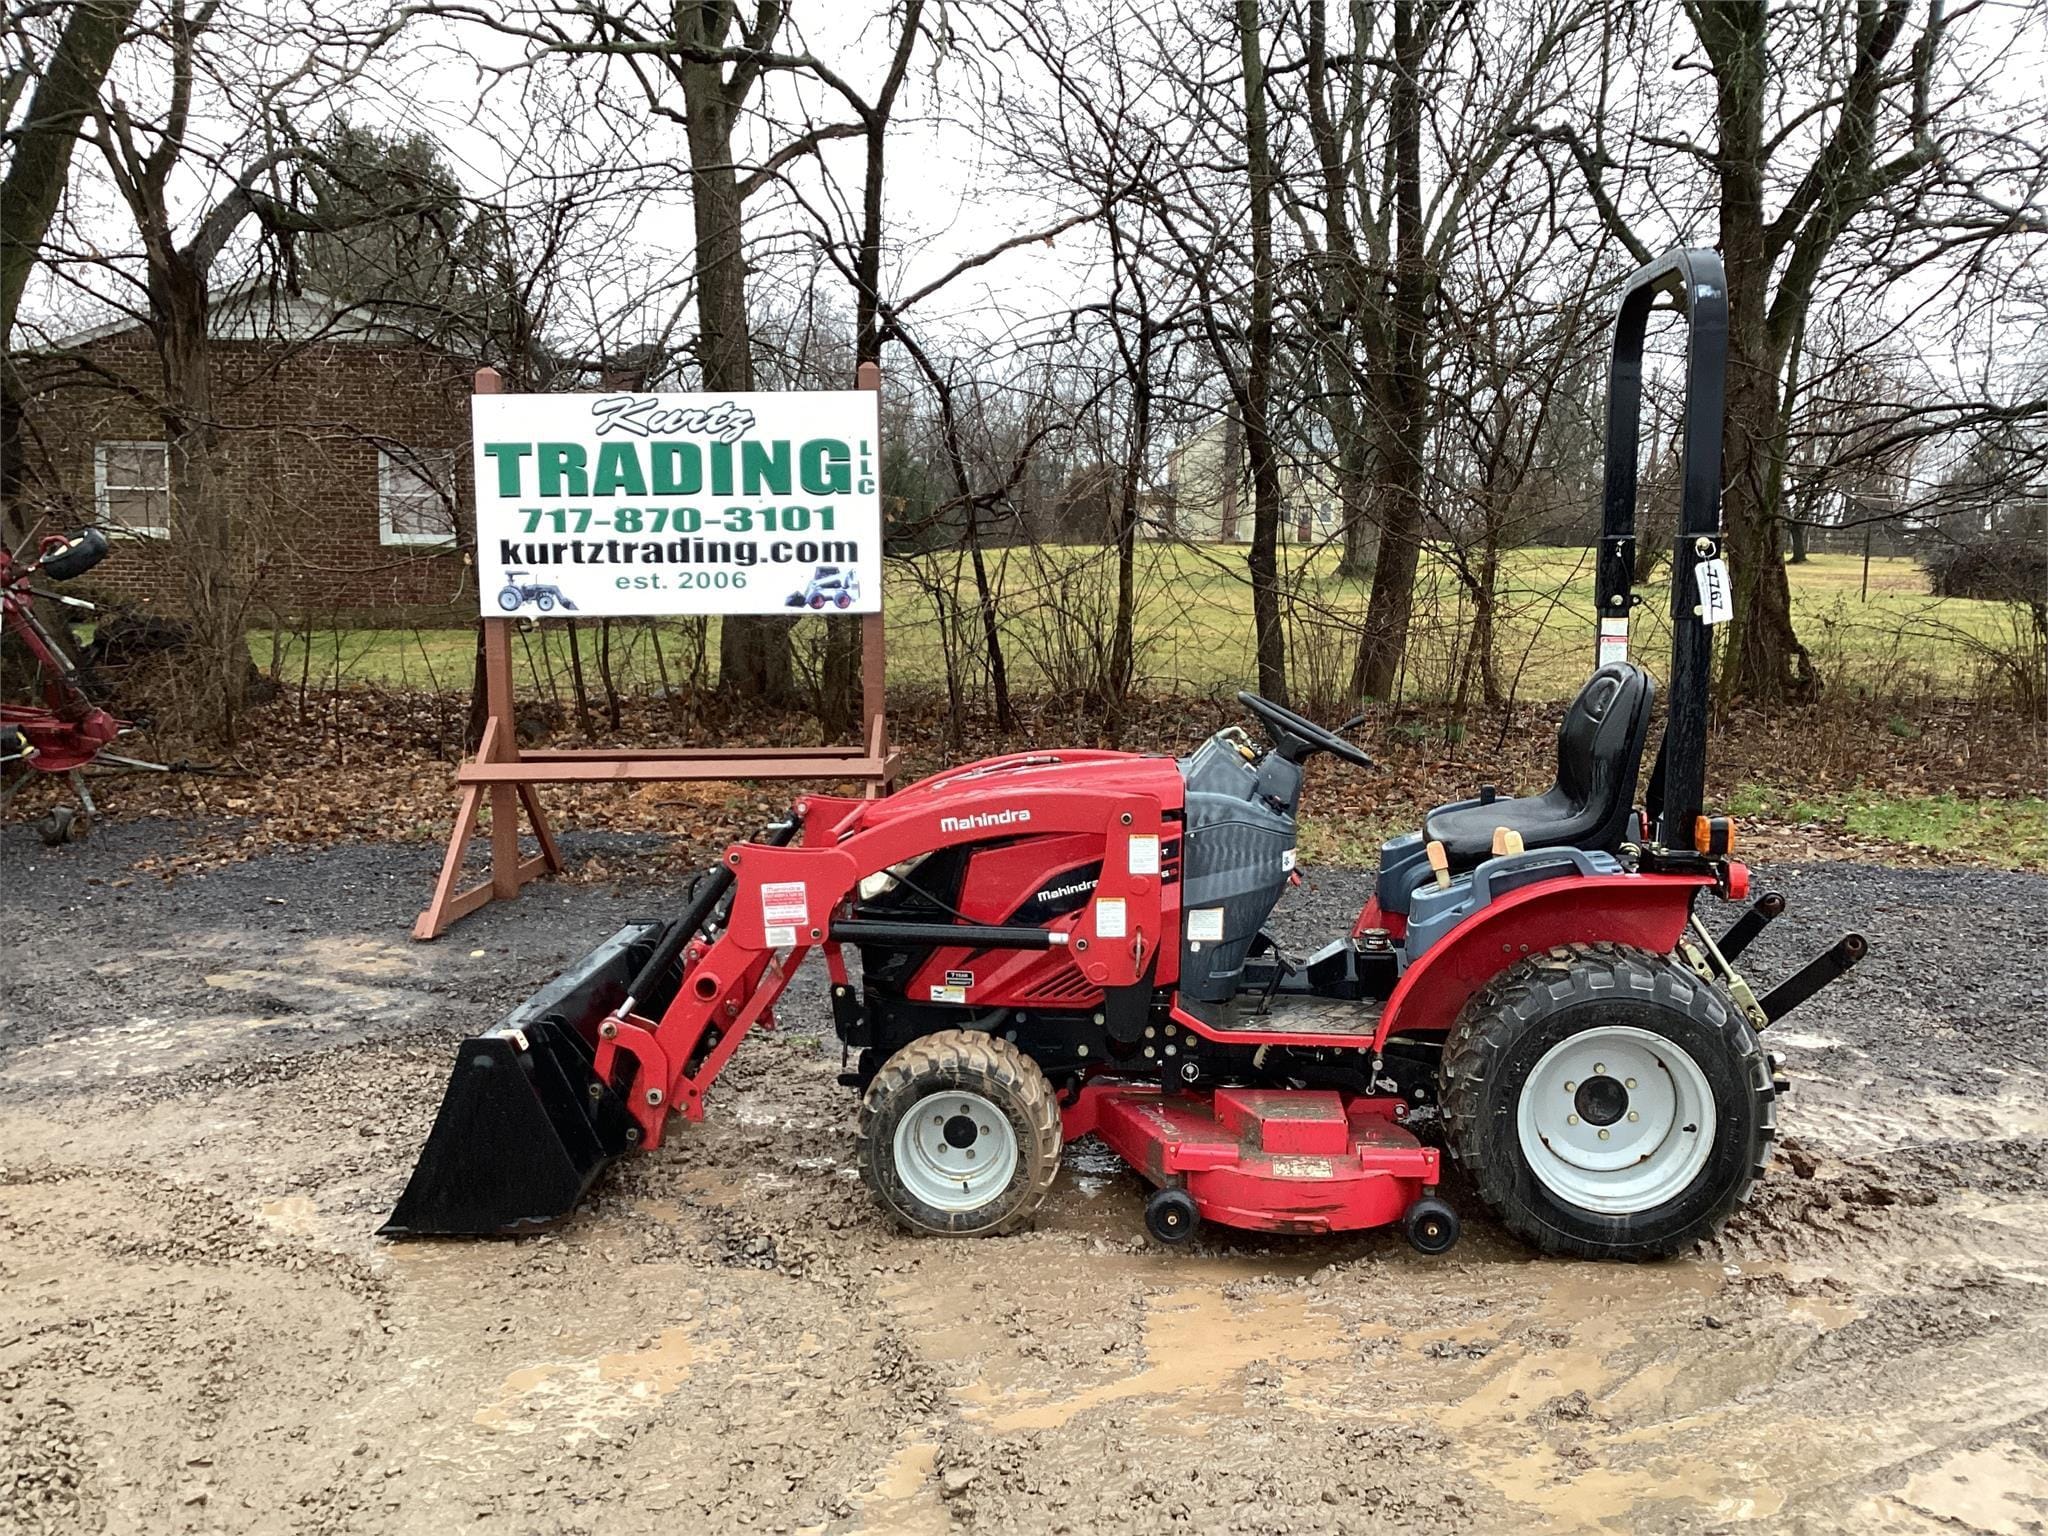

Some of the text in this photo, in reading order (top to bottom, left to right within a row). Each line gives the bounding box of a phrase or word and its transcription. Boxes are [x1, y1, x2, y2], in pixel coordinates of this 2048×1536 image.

[592, 396, 755, 445] Kurtz
[484, 438, 852, 498] TRADING
[857, 439, 876, 495] LLC
[518, 506, 835, 533] 717-870-3101
[500, 537, 859, 566] kurtztrading.com
[615, 571, 748, 589] est. 2006
[1706, 568, 1723, 610] 7767
[940, 808, 1031, 833] Mahindra
